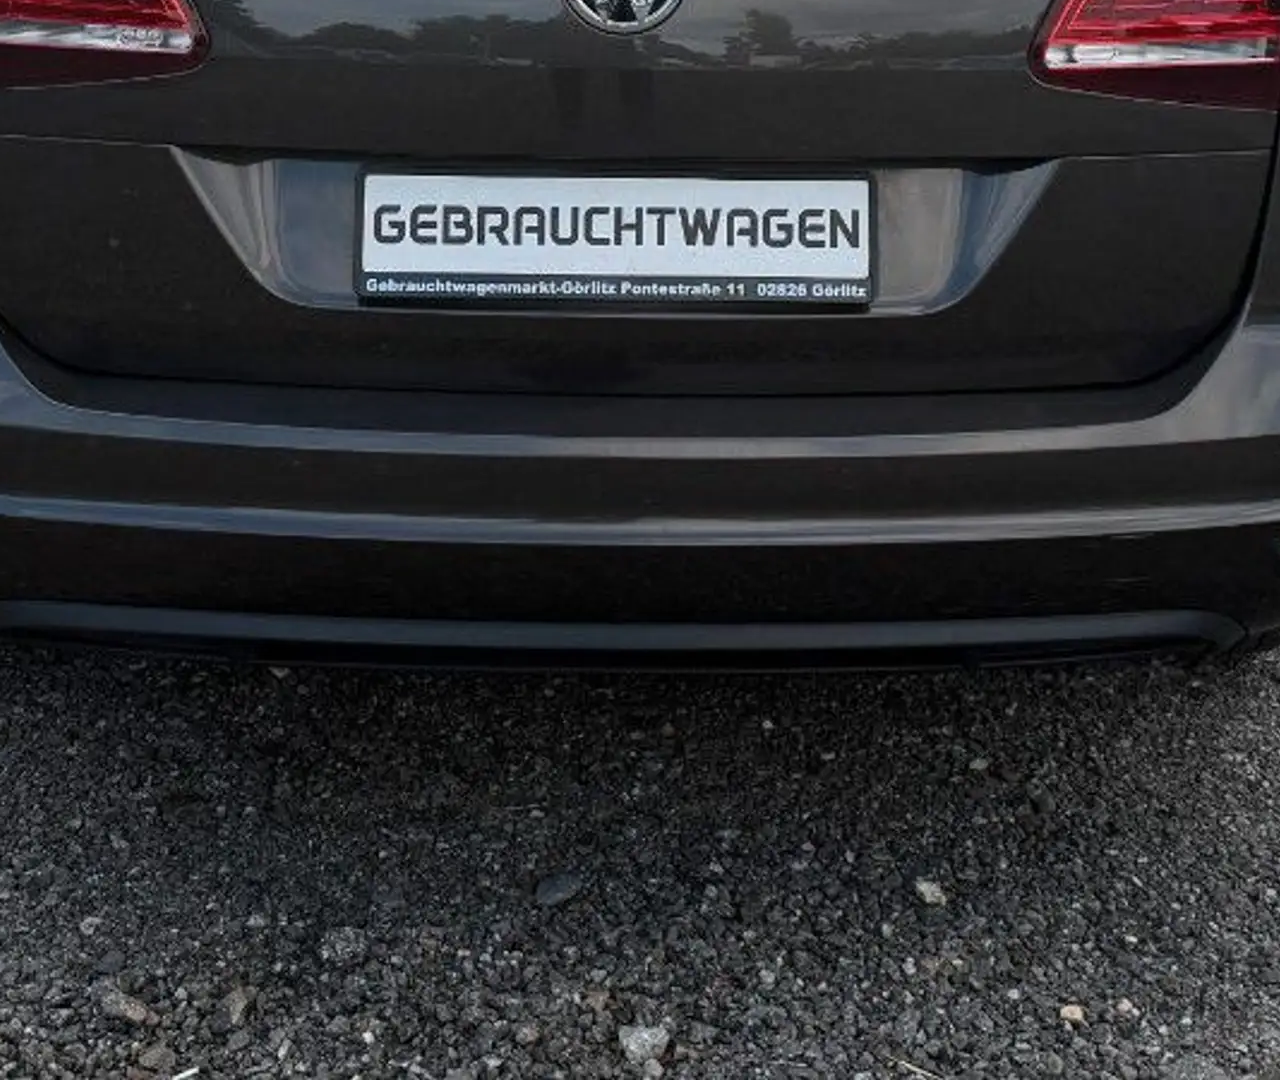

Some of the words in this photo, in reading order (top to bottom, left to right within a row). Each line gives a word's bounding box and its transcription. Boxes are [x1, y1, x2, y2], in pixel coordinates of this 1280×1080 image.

[373, 204, 860, 249] GEBRAUCHTWAGEN
[365, 278, 617, 297] Gebrauchtwagenmarkt-Görlitz
[620, 280, 721, 297] Pontestraße
[726, 282, 746, 297] 11
[756, 282, 807, 298] 02826
[812, 283, 867, 299] Görlitz
